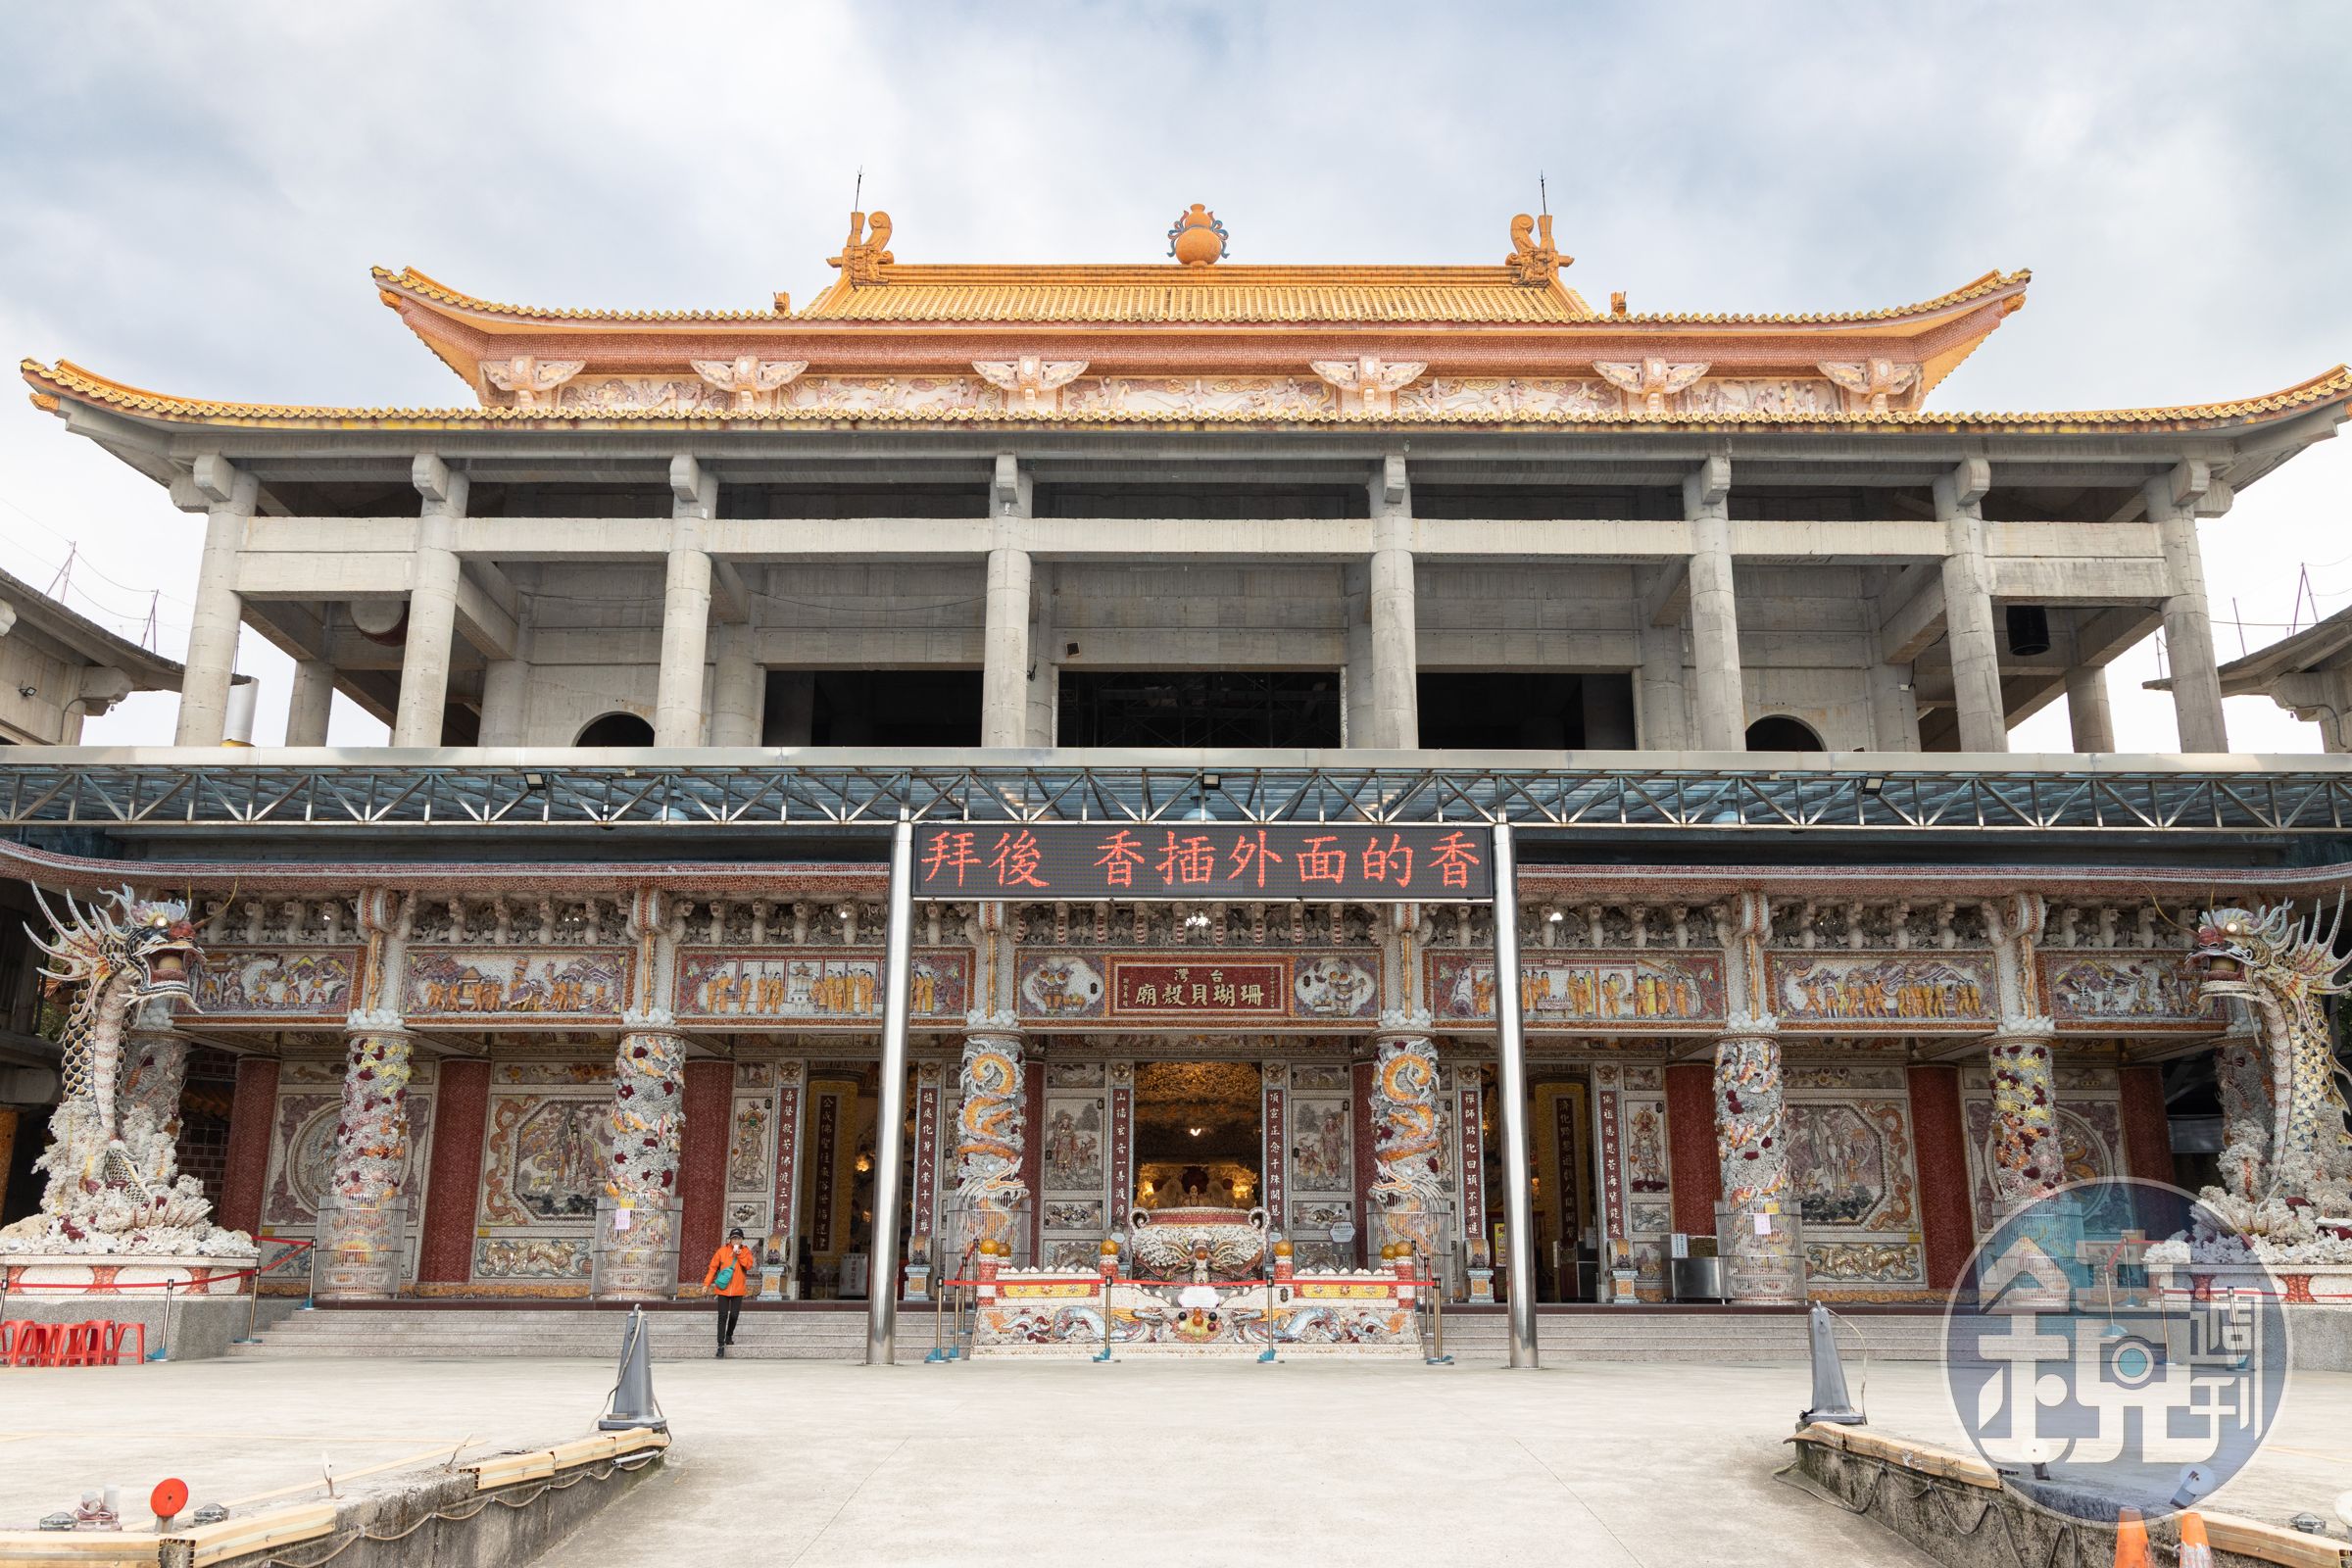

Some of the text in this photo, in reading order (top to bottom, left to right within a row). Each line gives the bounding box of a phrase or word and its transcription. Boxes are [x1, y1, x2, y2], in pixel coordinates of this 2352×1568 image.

[920, 829, 1481, 888] 拜後 香插外面的香
[1135, 983, 1264, 1007] 珊瑚貝殼廟
